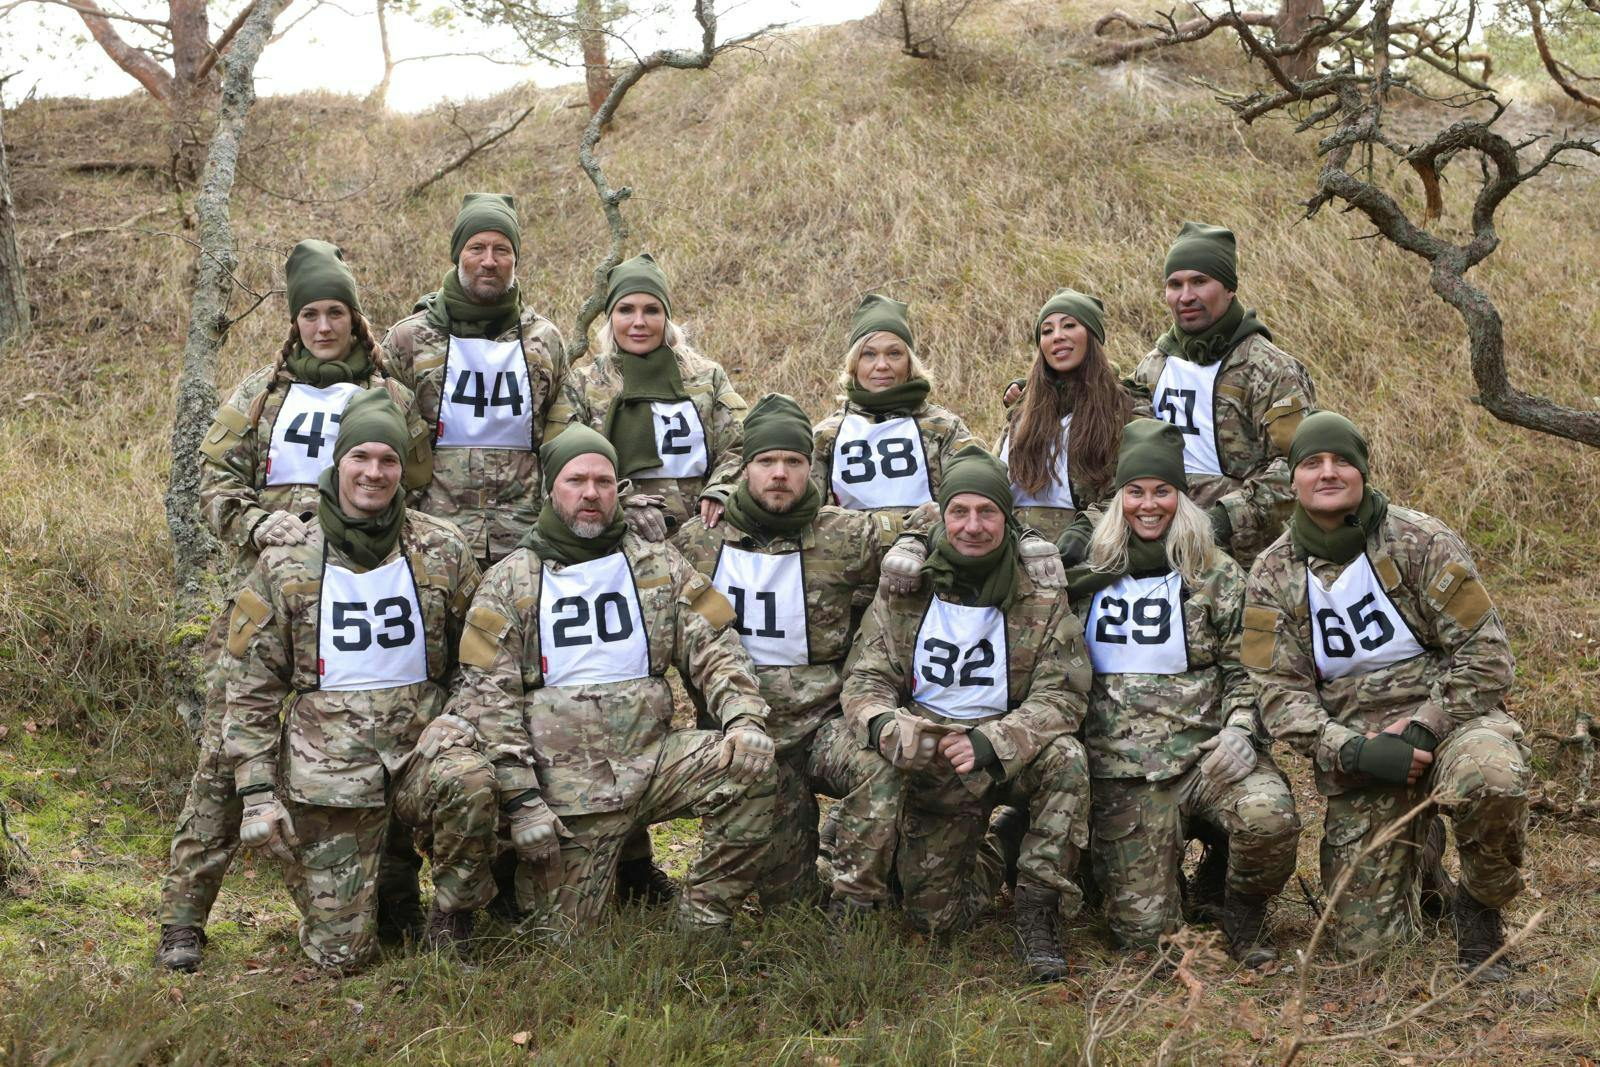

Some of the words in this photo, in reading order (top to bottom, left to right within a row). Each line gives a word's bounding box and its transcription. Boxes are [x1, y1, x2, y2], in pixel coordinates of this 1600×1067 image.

[451, 370, 524, 417] 44
[284, 412, 341, 458] 4
[841, 438, 917, 484] 38
[333, 596, 415, 651] 53
[552, 591, 633, 648] 20
[728, 586, 785, 638] 11
[1096, 596, 1171, 644] 29
[1316, 592, 1394, 658] 65
[921, 637, 994, 688] 32
